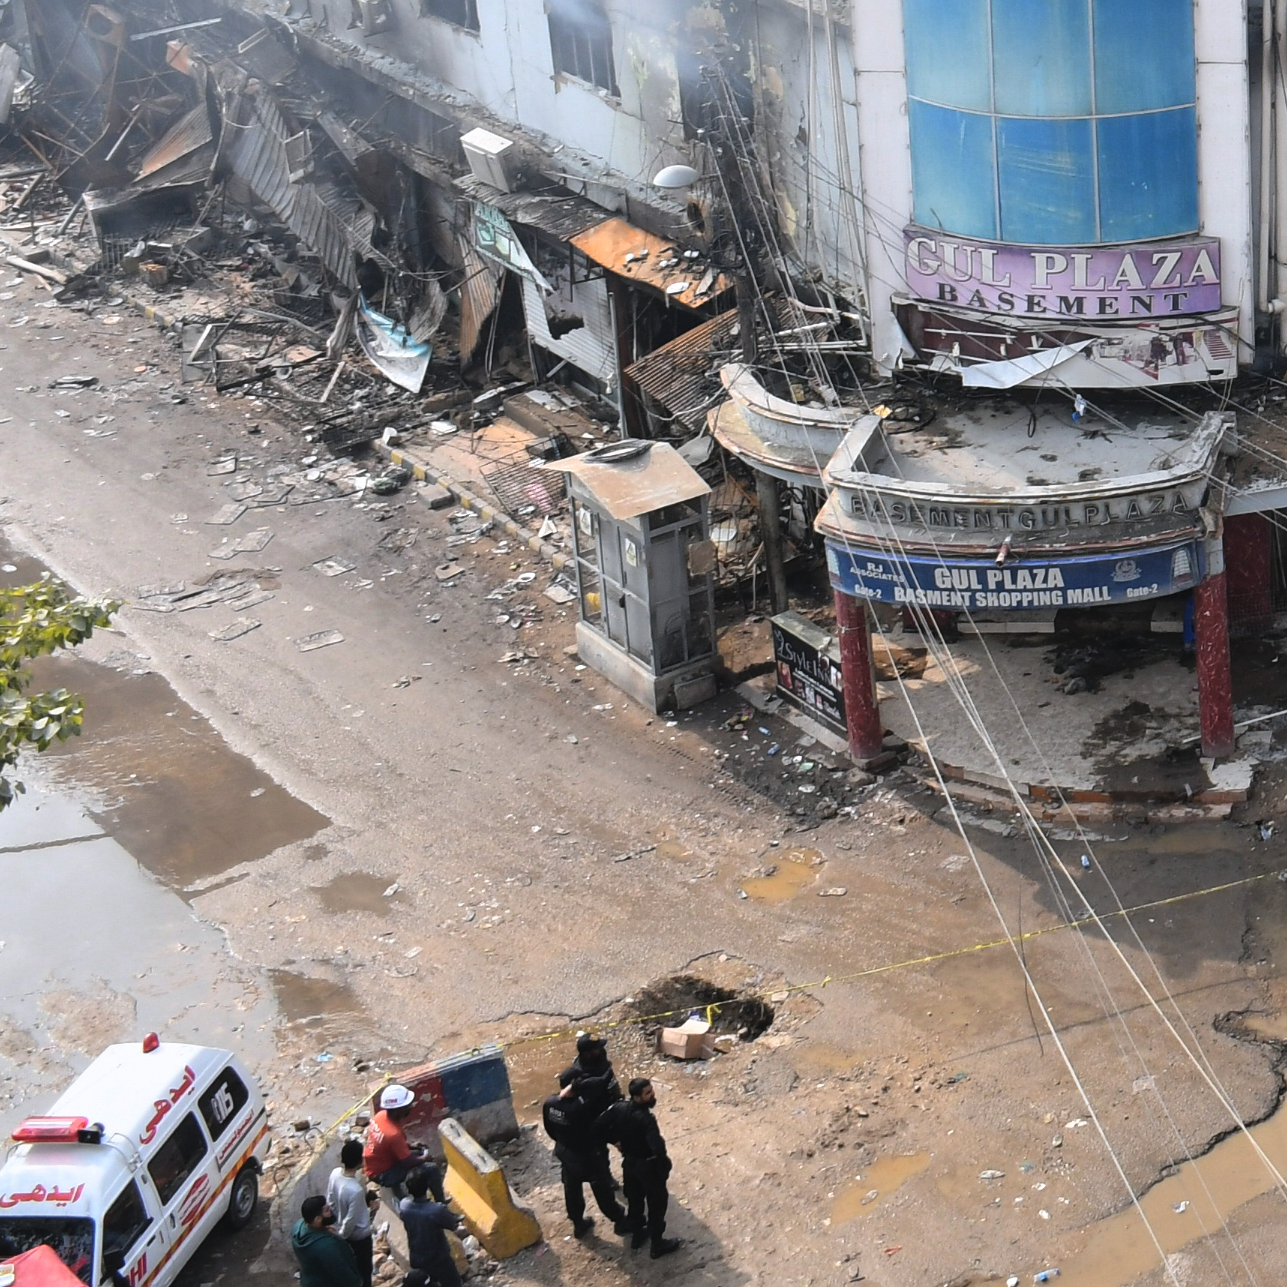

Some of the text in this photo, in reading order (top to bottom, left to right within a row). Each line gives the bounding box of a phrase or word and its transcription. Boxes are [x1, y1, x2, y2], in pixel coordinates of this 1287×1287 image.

[904, 236, 1222, 294] GUL PLAZA
[935, 280, 1189, 317] BASEMENT
[866, 562, 884, 573] RJ
[934, 567, 1065, 590] GUL PLAZA
[894, 586, 972, 606] BASMENT
[975, 591, 1064, 608] SHOPPING
[1067, 585, 1111, 605] MALL
[1126, 583, 1158, 598] Gate-2
[139, 1065, 197, 1144] ایدھی
[0, 1183, 86, 1208] ایدھی
